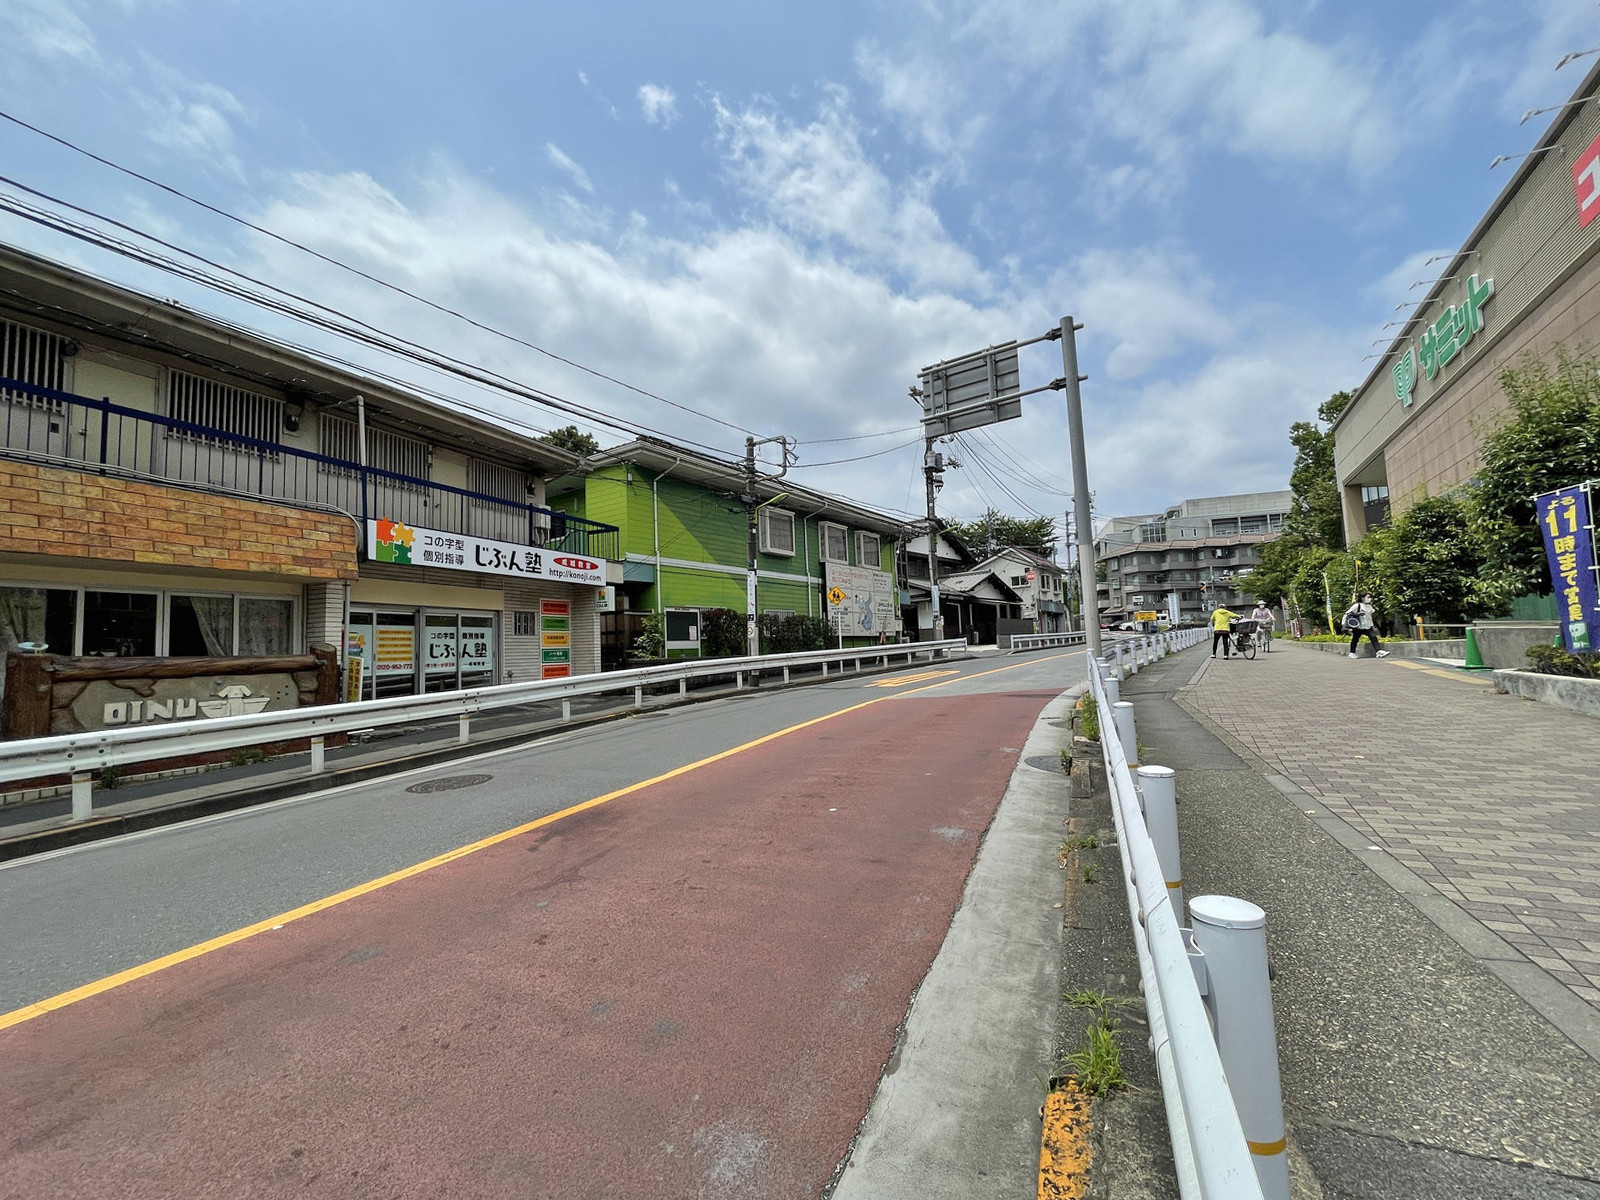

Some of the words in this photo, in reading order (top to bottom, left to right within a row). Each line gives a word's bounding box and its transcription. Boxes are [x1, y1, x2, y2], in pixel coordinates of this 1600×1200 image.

[1419, 273, 1495, 381] サミット
[1547, 496, 1576, 510] よる
[1545, 505, 1578, 537] 11
[423, 535, 465, 551] コの字型
[423, 549, 465, 566] 個別指導
[474, 544, 543, 574] じぶん塾
[1554, 536, 1583, 621] 時まで営業
[430, 632, 455, 640] コの字型
[462, 632, 485, 640] 個別指導
[429, 642, 488, 659] じぶん塾
[103, 699, 197, 725] OINU
